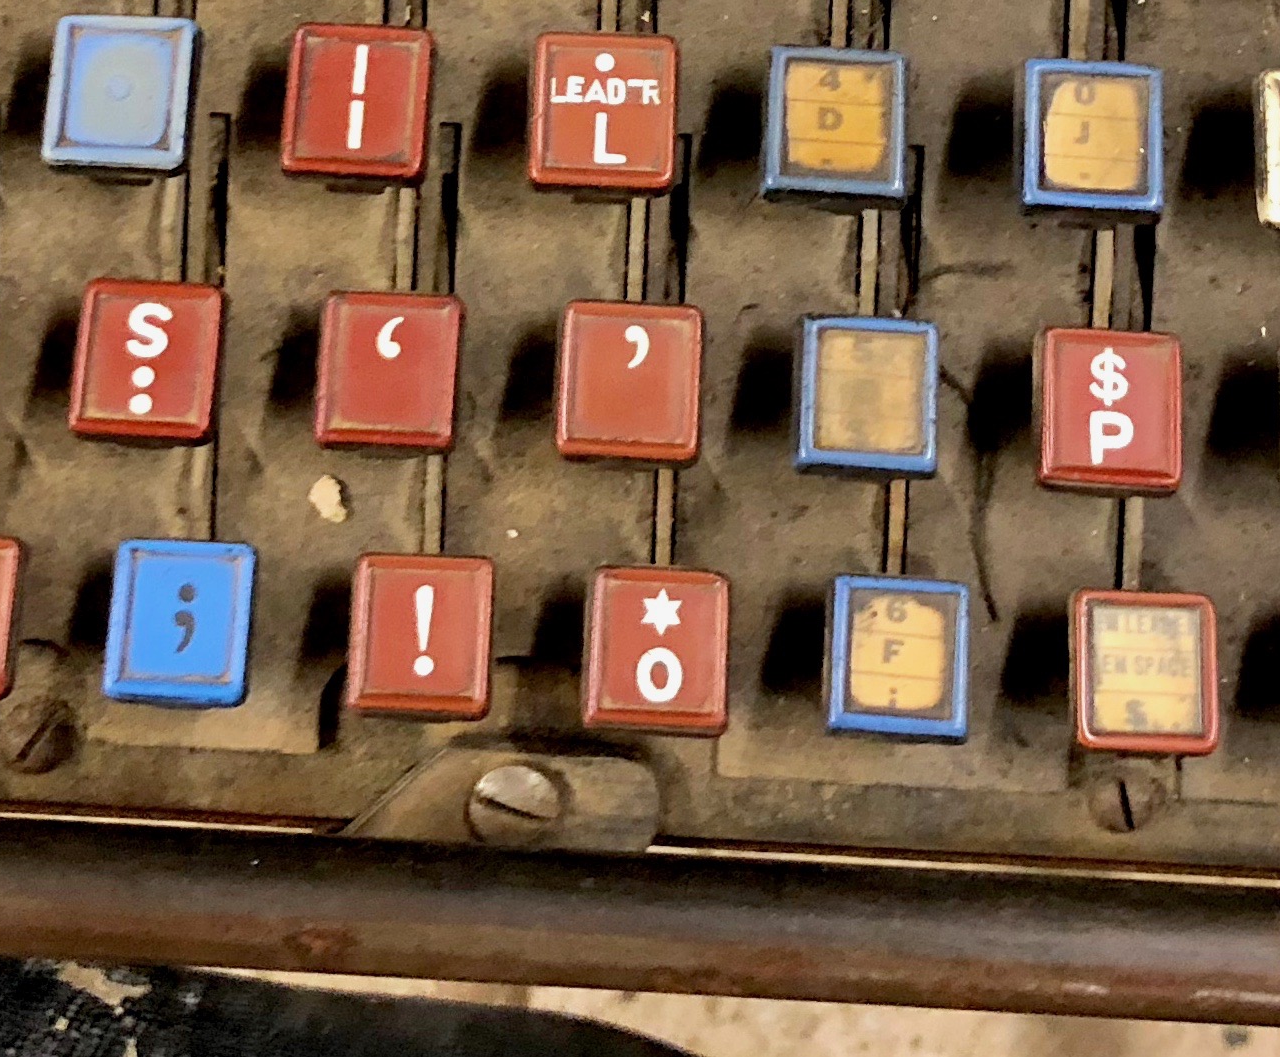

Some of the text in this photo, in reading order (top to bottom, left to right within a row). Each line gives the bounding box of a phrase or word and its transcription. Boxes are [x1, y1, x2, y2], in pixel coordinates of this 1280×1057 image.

[593, 110, 628, 165] L
[126, 301, 174, 358] S
[1088, 346, 1129, 407] $
[1088, 410, 1134, 466] P
[174, 581, 198, 655] ;
[412, 583, 437, 678] !
